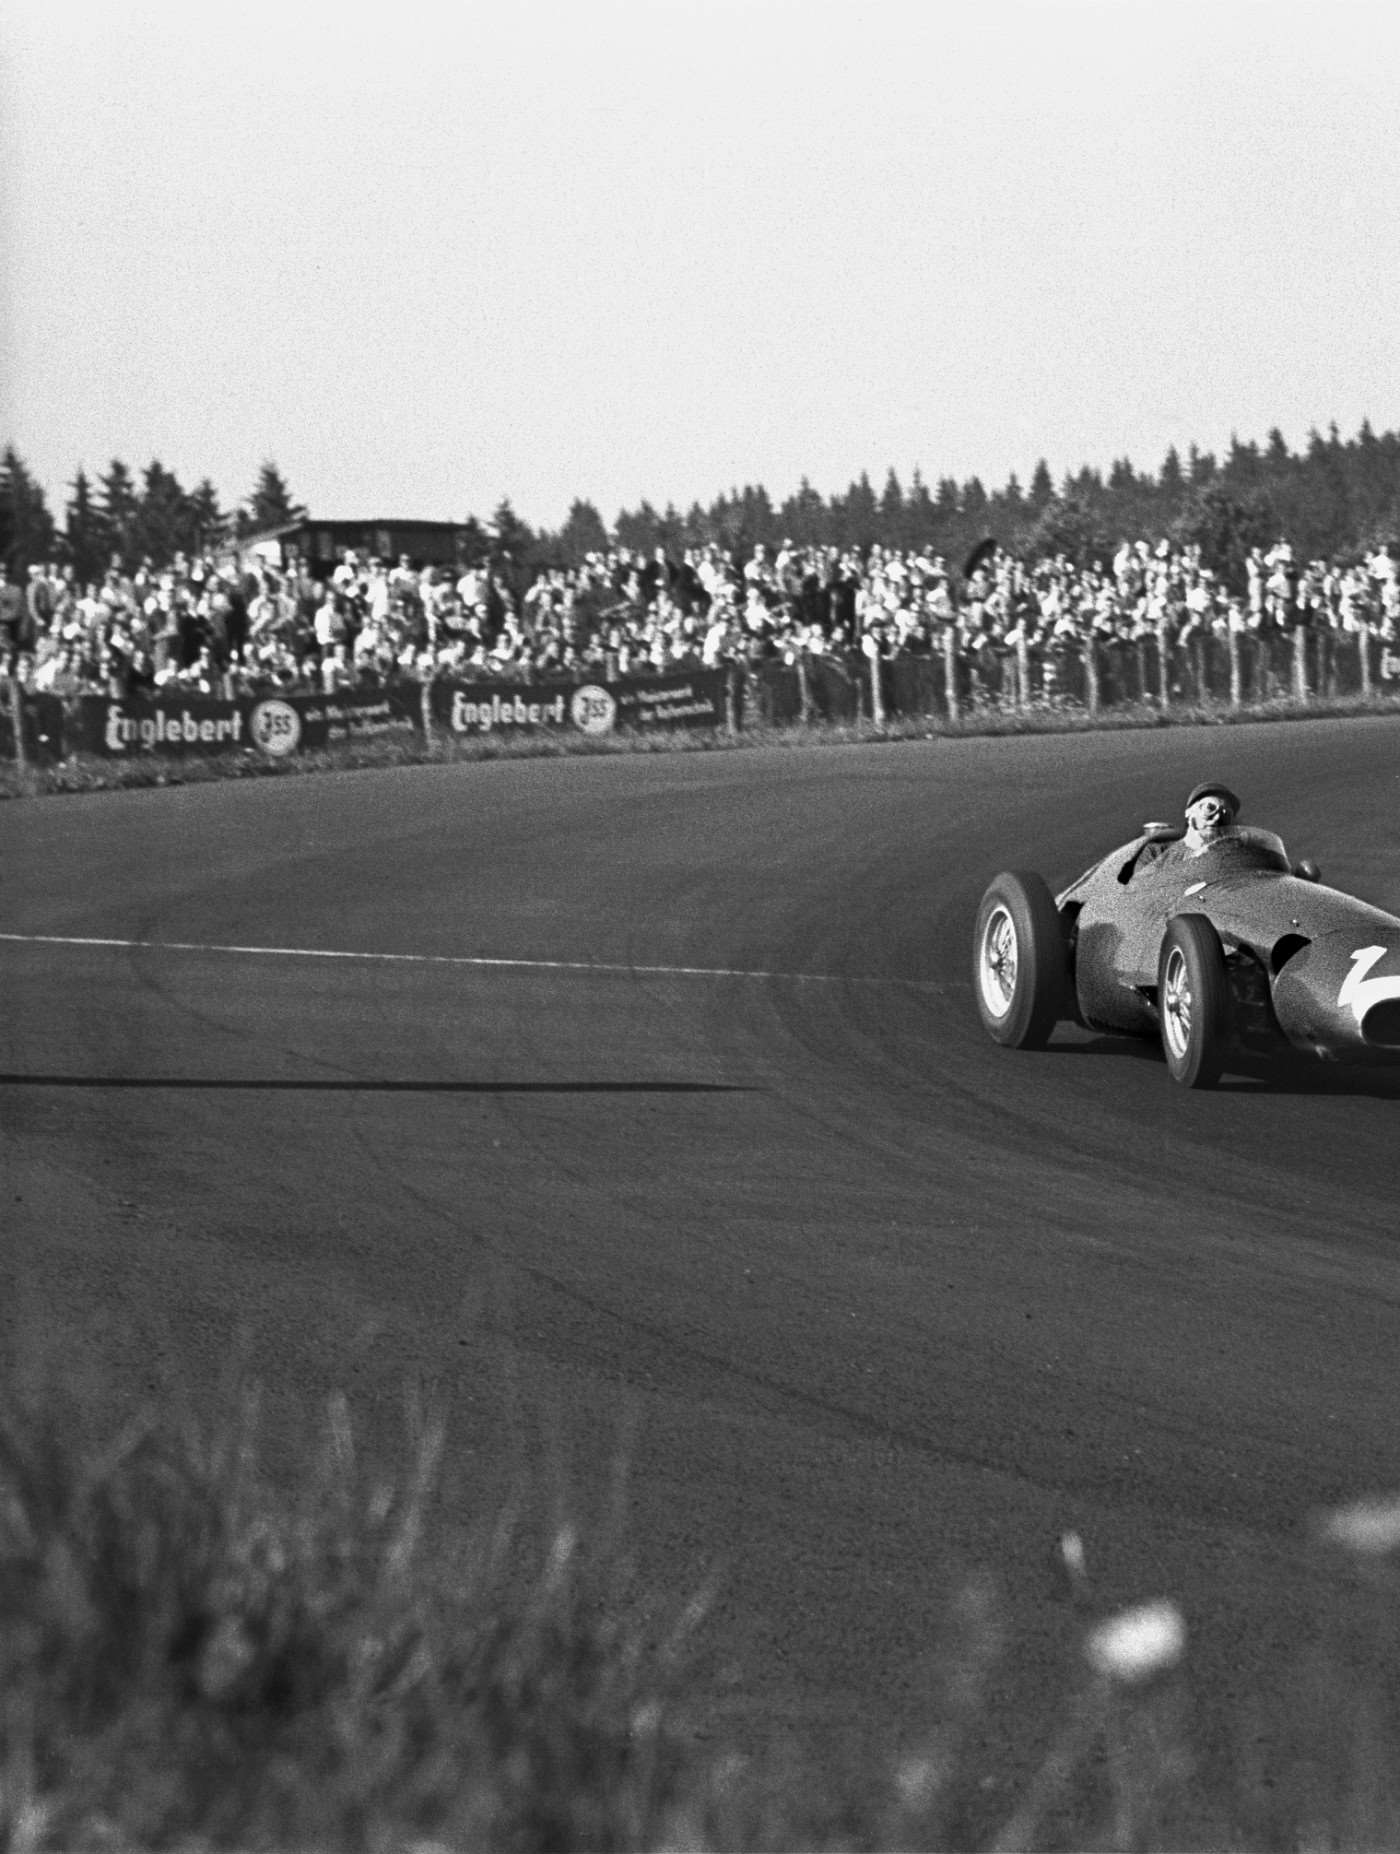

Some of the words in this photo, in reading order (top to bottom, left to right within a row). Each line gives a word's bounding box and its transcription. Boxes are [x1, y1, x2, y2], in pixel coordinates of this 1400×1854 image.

[105, 705, 241, 749] Englebert
[452, 690, 564, 731] Englebert
[1337, 945, 1388, 1008] 1
